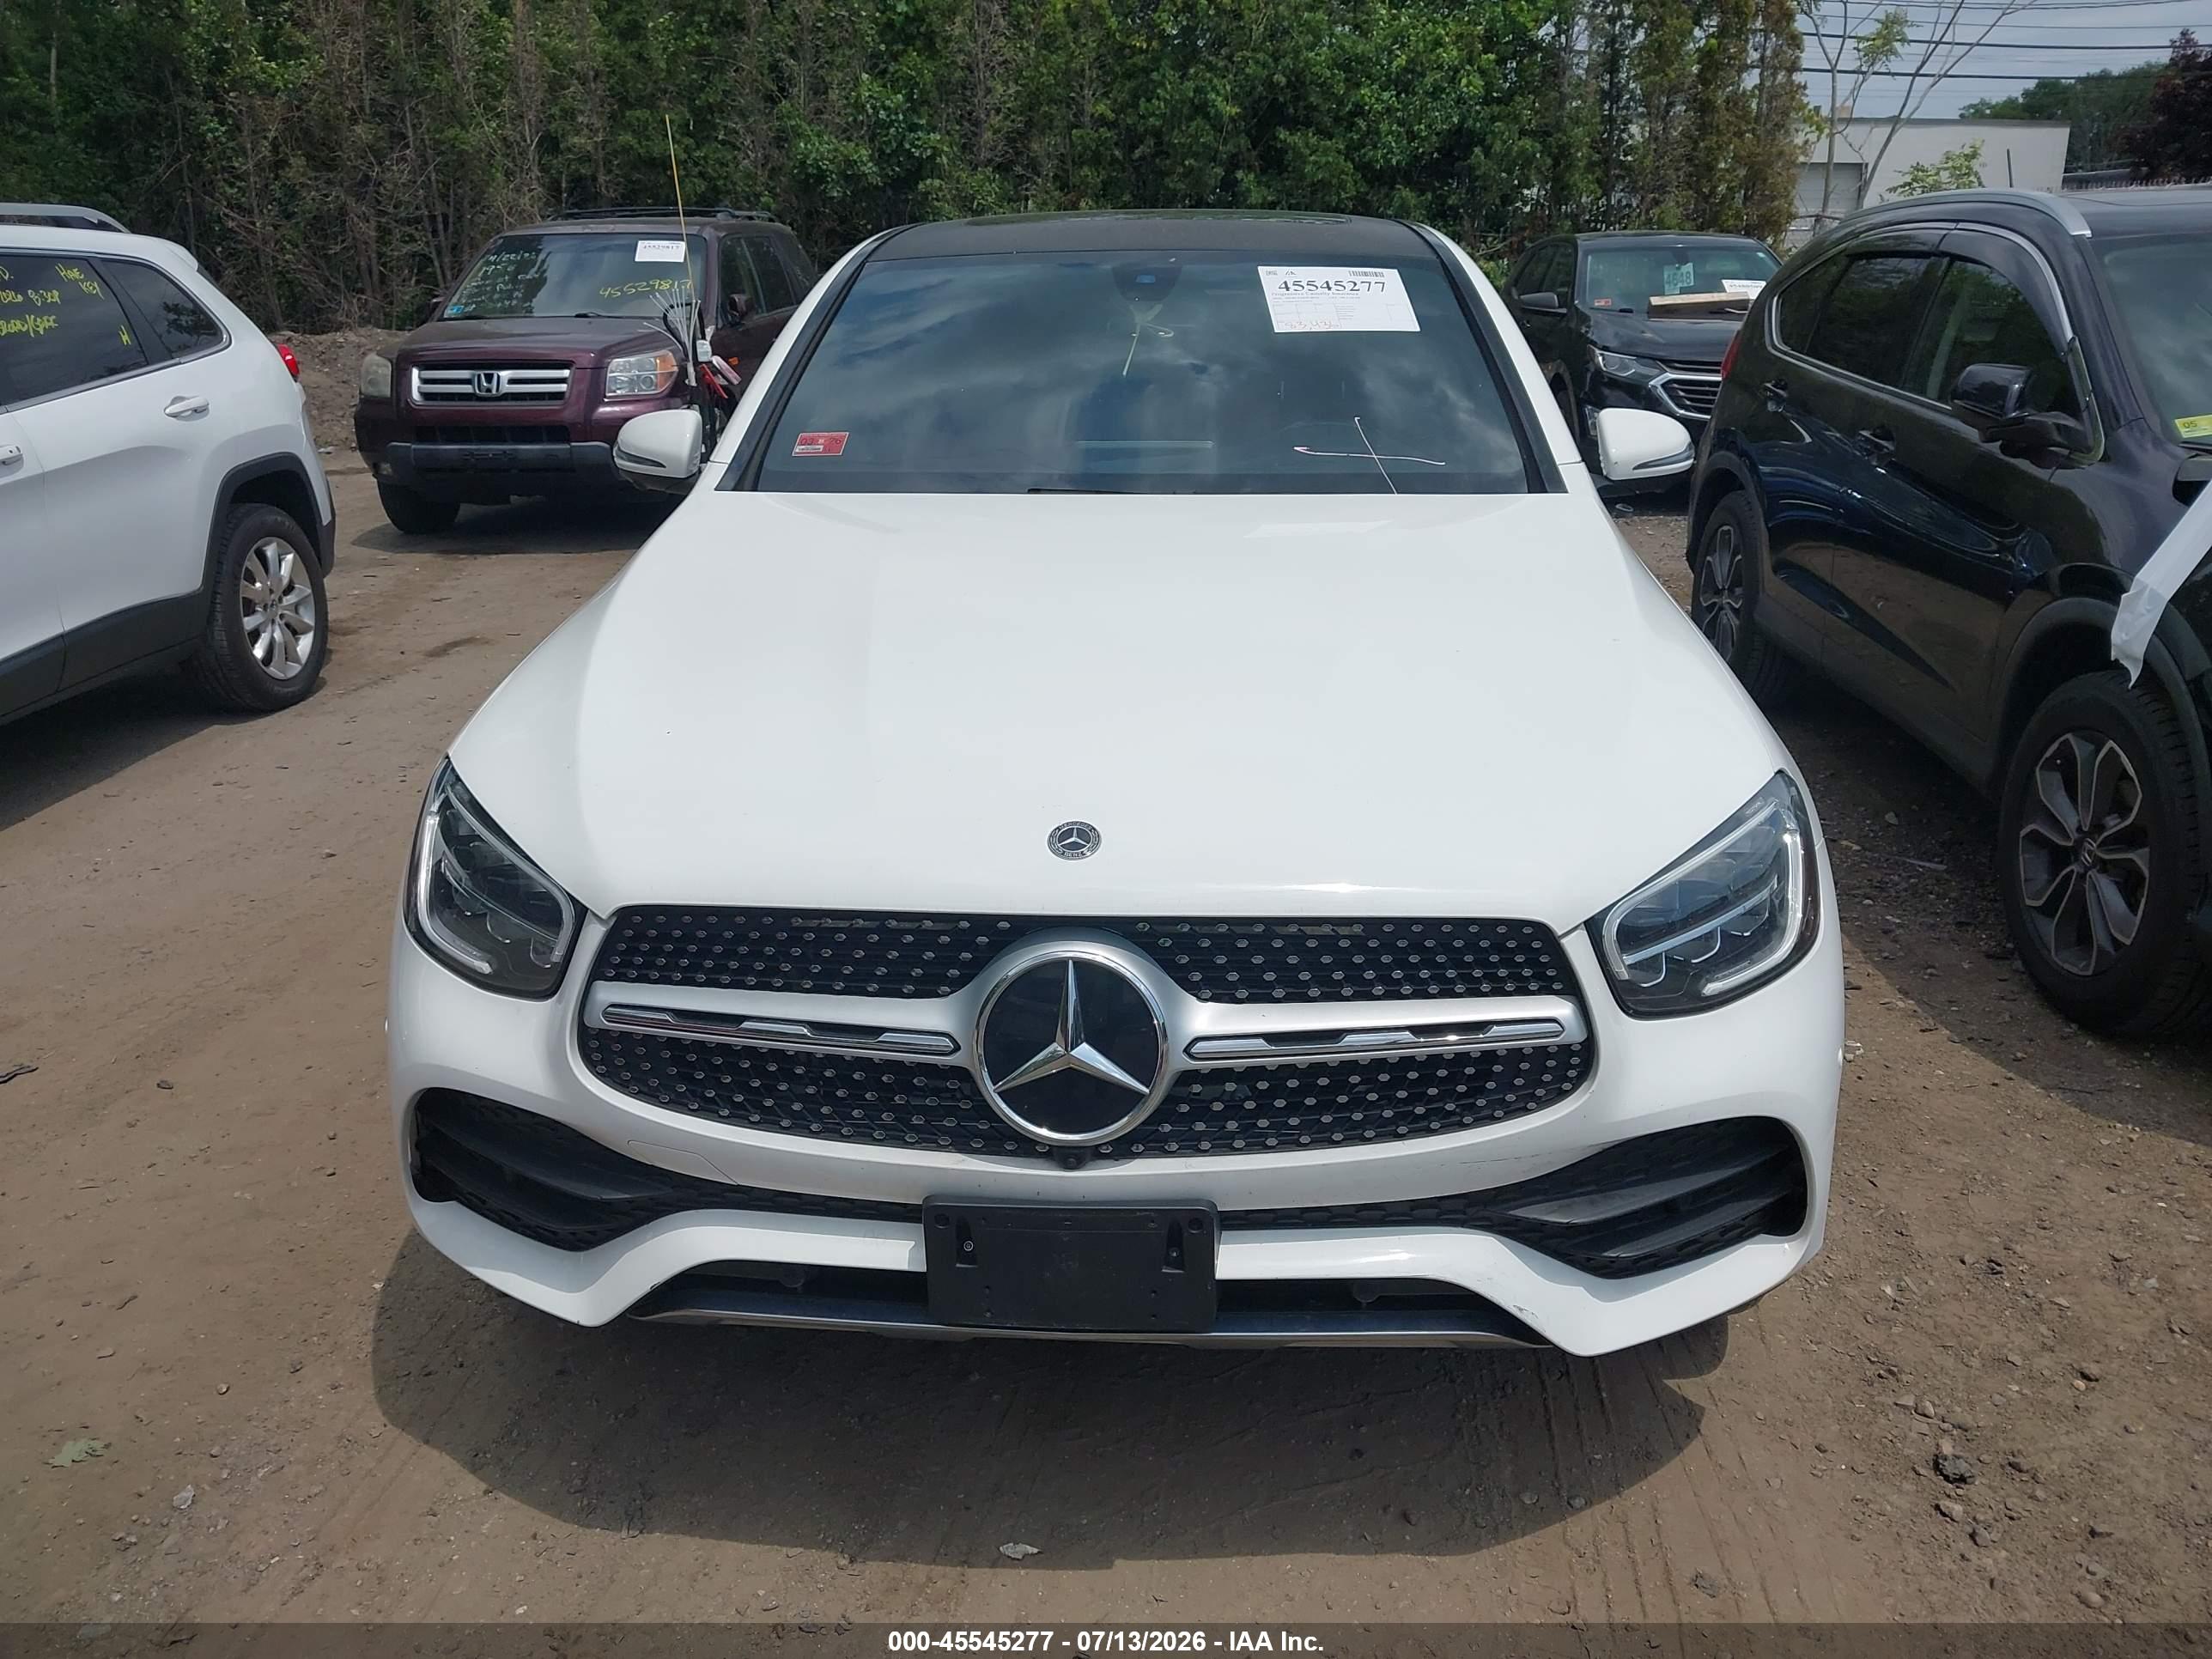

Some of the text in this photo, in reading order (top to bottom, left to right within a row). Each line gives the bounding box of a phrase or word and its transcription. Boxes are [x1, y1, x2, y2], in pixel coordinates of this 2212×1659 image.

[78, 281, 104, 301] KEY
[599, 279, 694, 298] 45529817
[1278, 280, 1386, 293] 45545277
[118, 325, 131, 345] H
